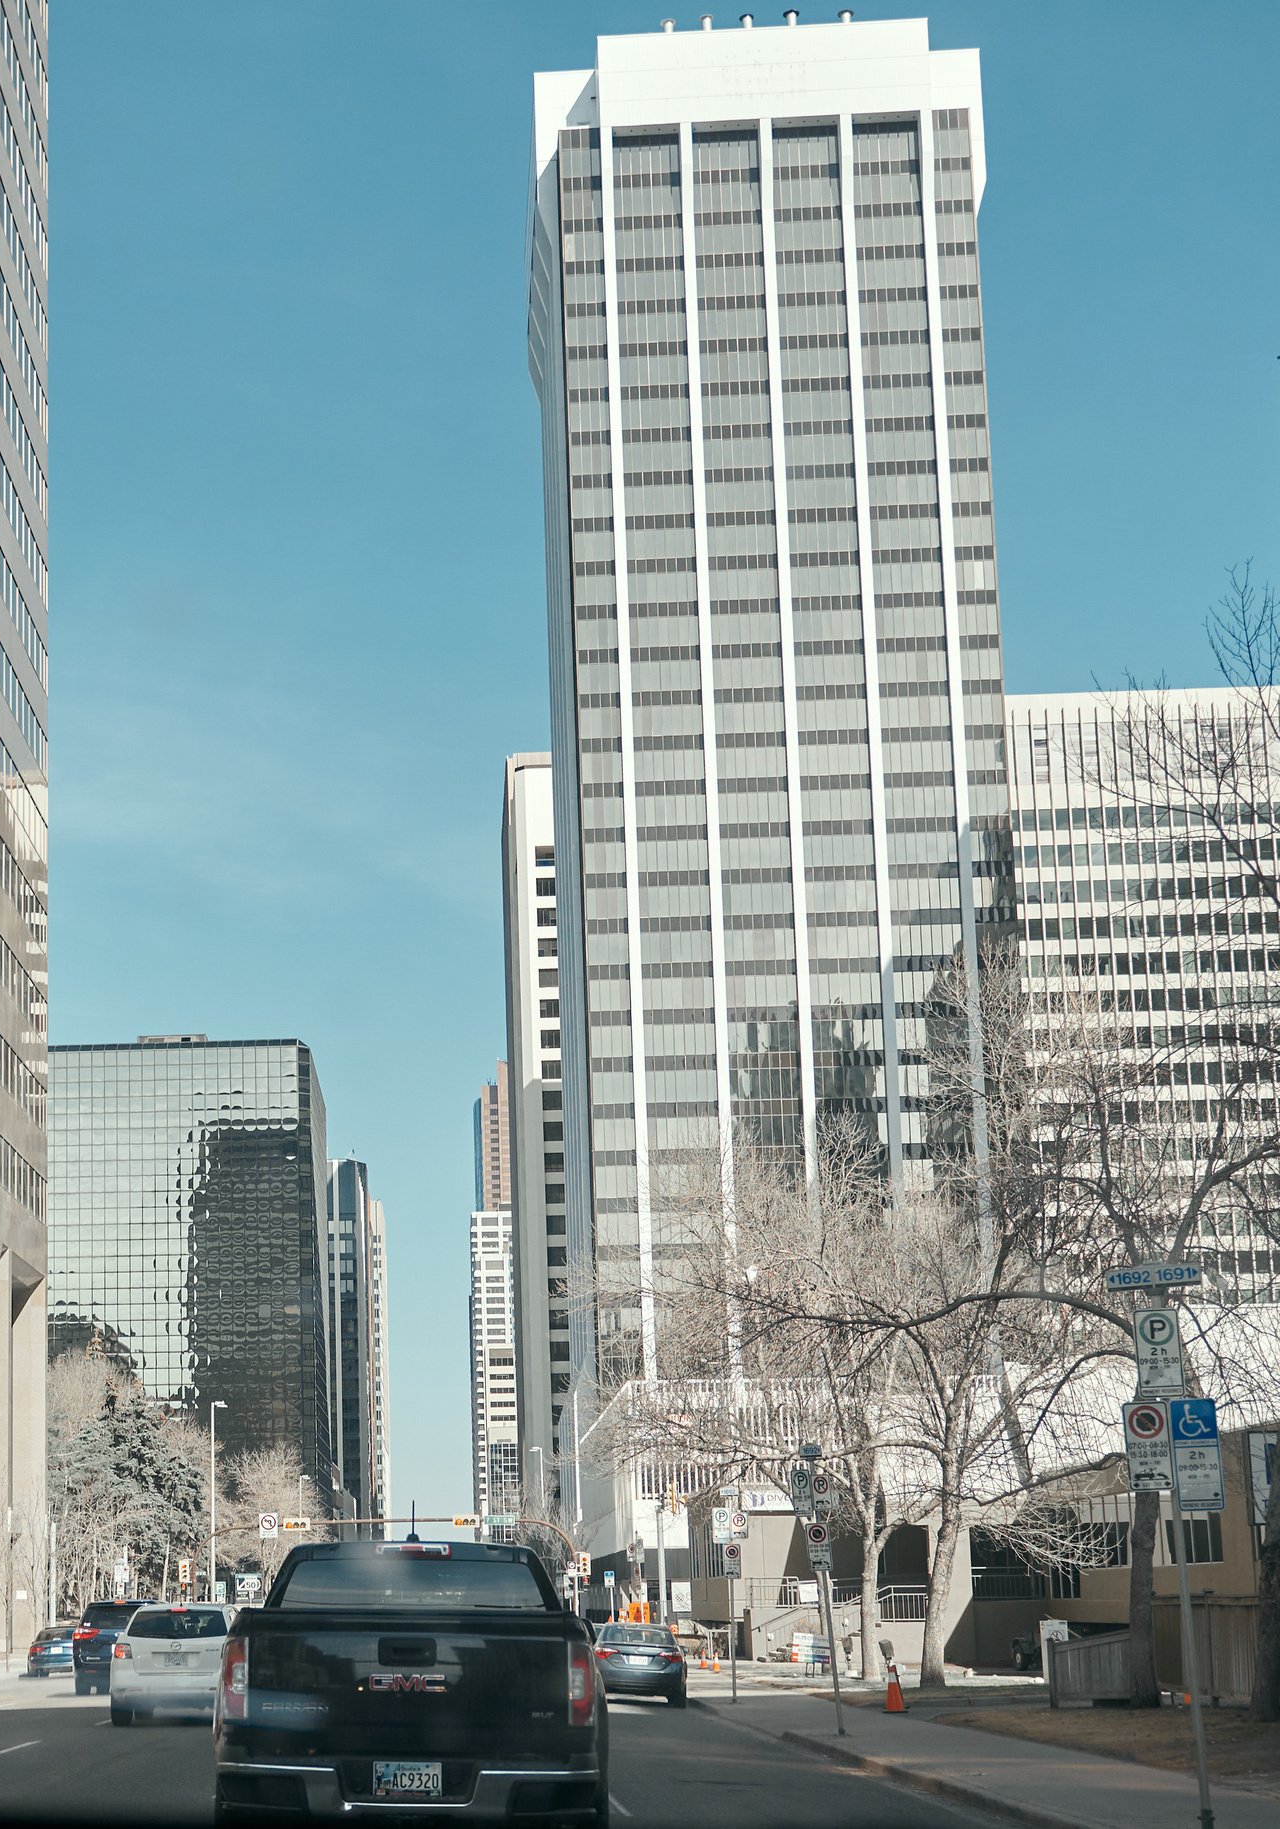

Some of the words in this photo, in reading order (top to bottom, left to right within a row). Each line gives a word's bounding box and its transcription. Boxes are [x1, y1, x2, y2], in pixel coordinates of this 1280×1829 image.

[1115, 1270, 1151, 1285] 1692
[1155, 1267, 1192, 1282] 1691
[1149, 1319, 1167, 1339] P
[1150, 1347, 1158, 1356] 2
[1160, 1347, 1167, 1356] h
[1128, 1441, 1168, 1450] 07:00-08:30
[803, 1447, 818, 1455] 1692
[1129, 1450, 1169, 1459] 15:30-18:00
[1189, 1451, 1197, 1460] 2
[1199, 1451, 1206, 1459] h
[797, 1475, 805, 1485] P
[246, 1581, 256, 1589] 50
[370, 1674, 446, 1692] GMC
[392, 1772, 439, 1789] AC9320
